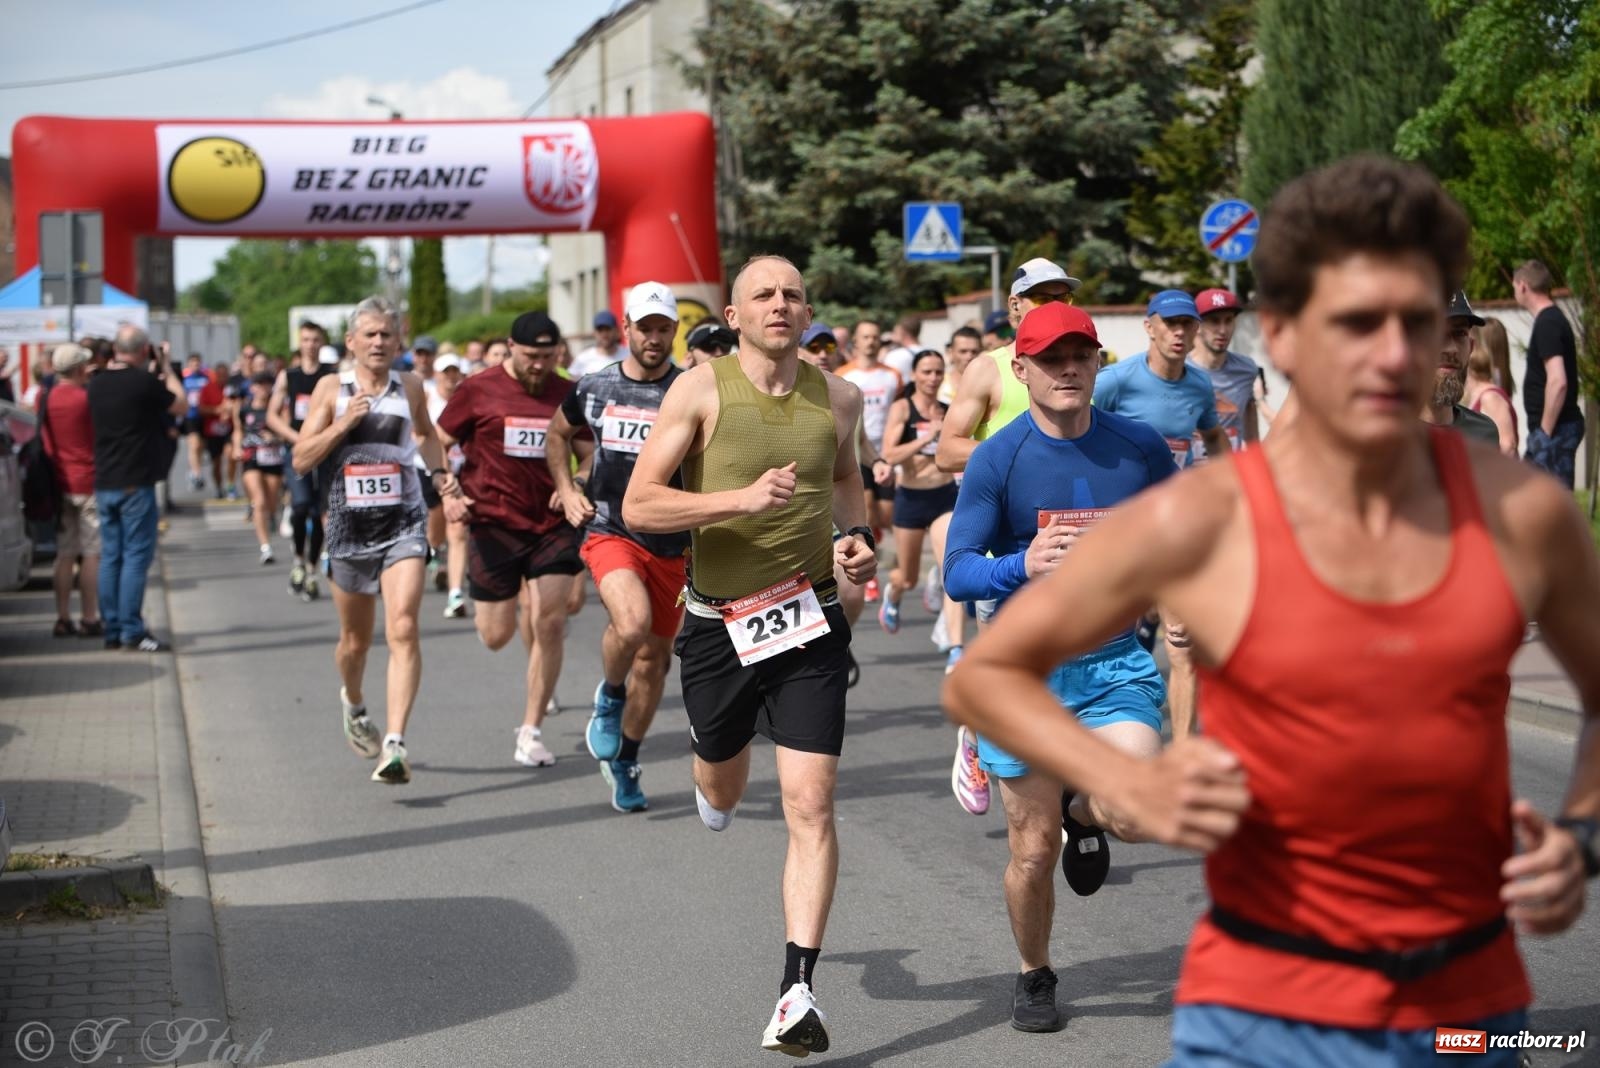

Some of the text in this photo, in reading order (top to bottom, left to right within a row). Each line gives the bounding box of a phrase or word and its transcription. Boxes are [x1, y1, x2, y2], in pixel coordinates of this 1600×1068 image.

[352, 136, 426, 154] BIEG
[294, 166, 487, 190] BEZ GRANIC
[308, 196, 471, 222] RACIBÓRZ
[518, 430, 545, 447] 217
[357, 477, 391, 495] 135
[744, 596, 758, 606] BIEG
[758, 591, 772, 600] BEZ
[772, 580, 797, 593] GRANIC
[746, 600, 801, 644] 237
